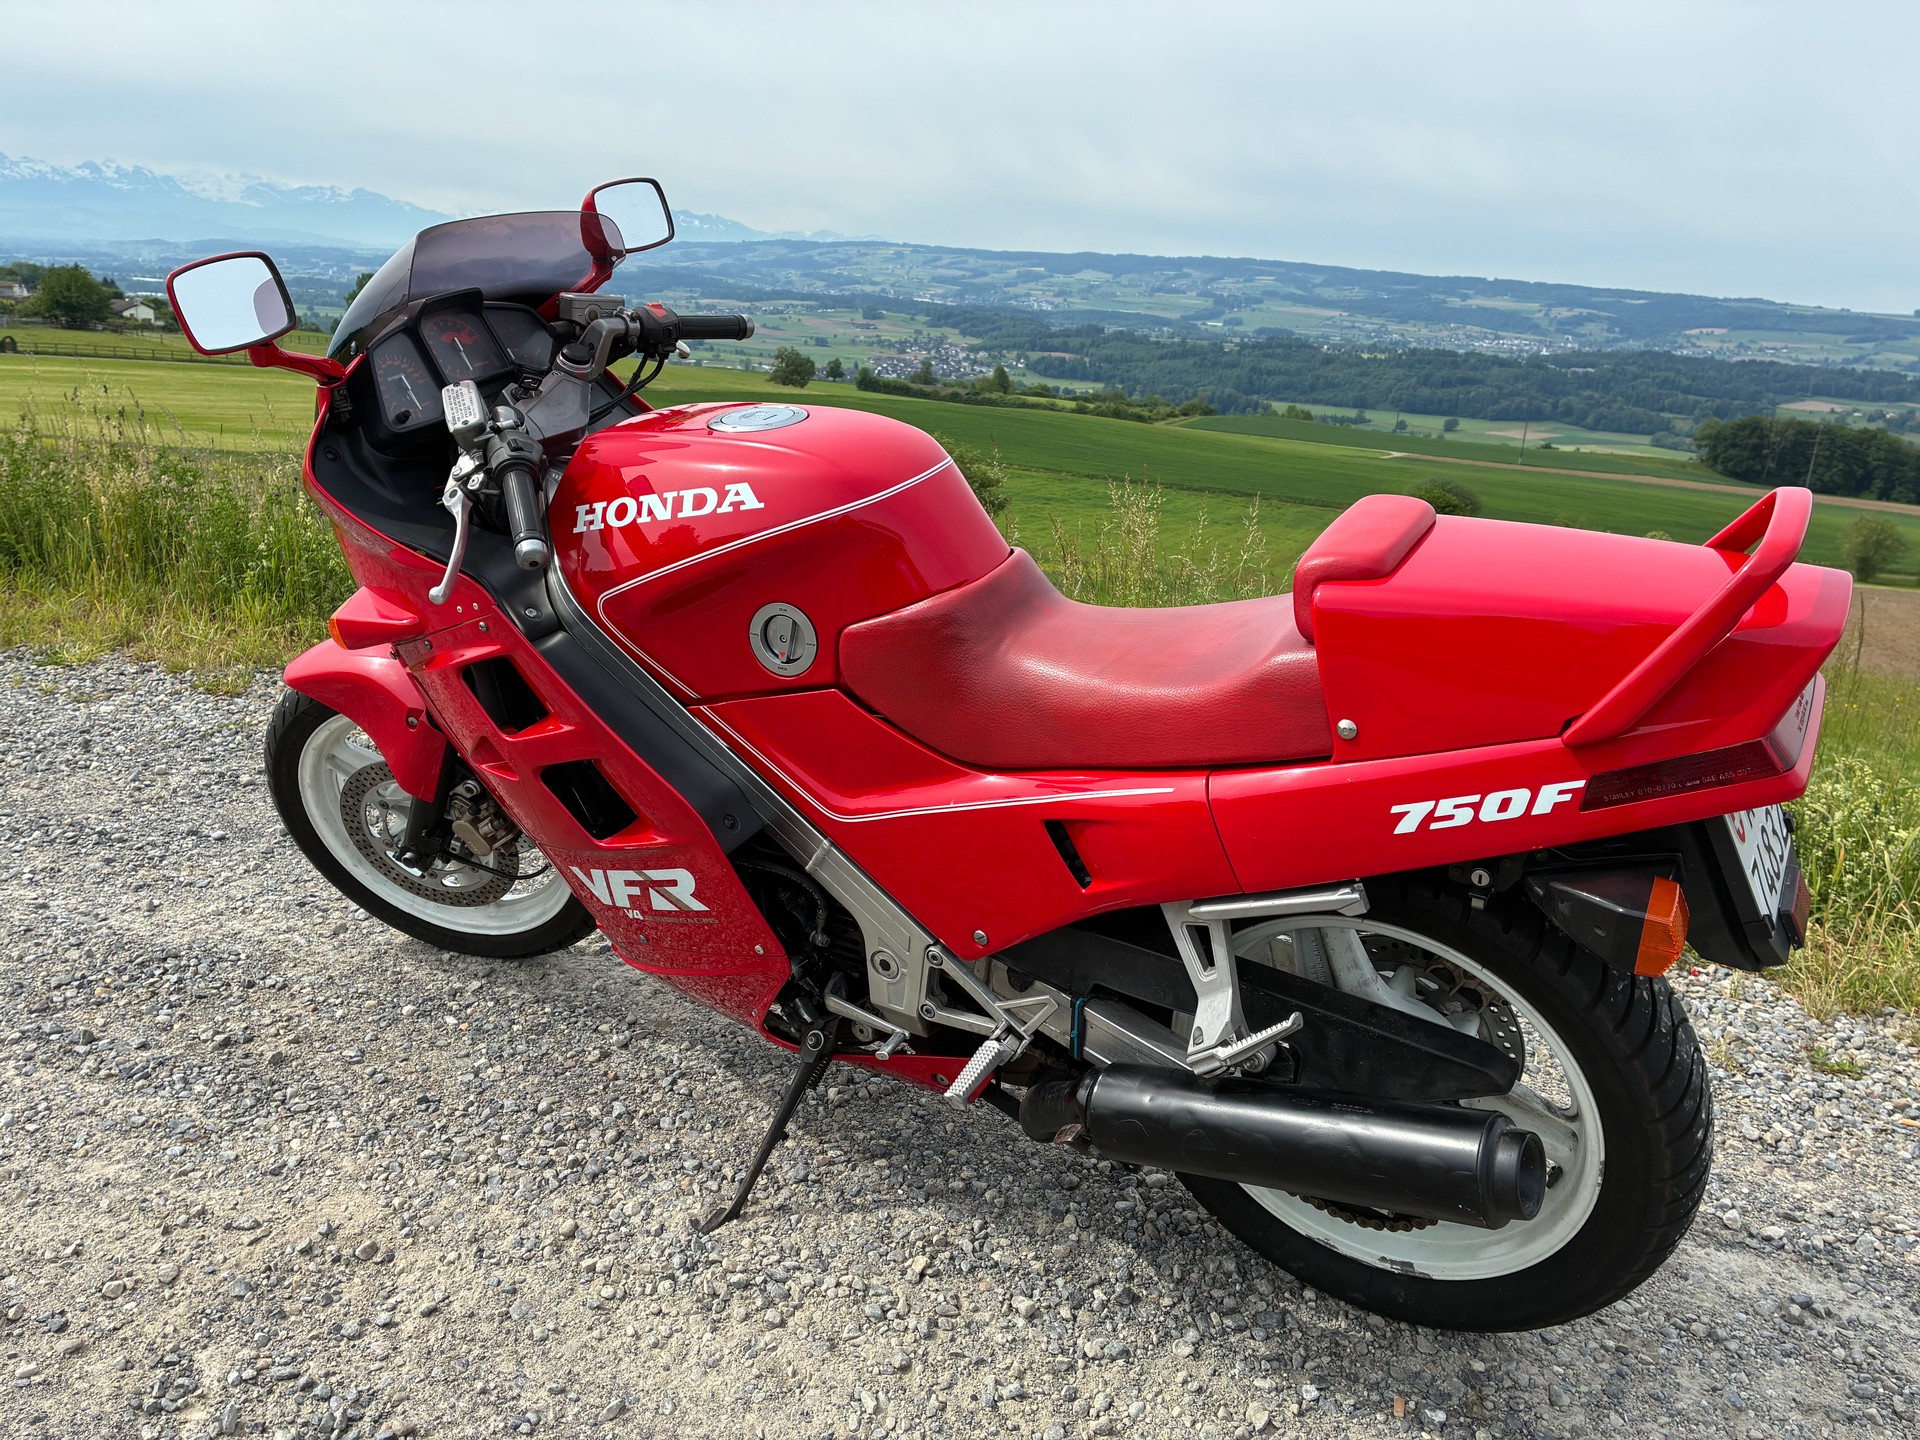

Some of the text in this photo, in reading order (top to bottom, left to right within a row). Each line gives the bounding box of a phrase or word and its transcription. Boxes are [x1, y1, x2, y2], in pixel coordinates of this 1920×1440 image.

[573, 482, 764, 533] HONDA
[1390, 780, 1586, 835] 750F
[1603, 790, 1635, 802] STANLEY
[1701, 774, 1718, 784] SAE
[568, 866, 710, 912] VFR
[624, 909, 644, 921] V4
